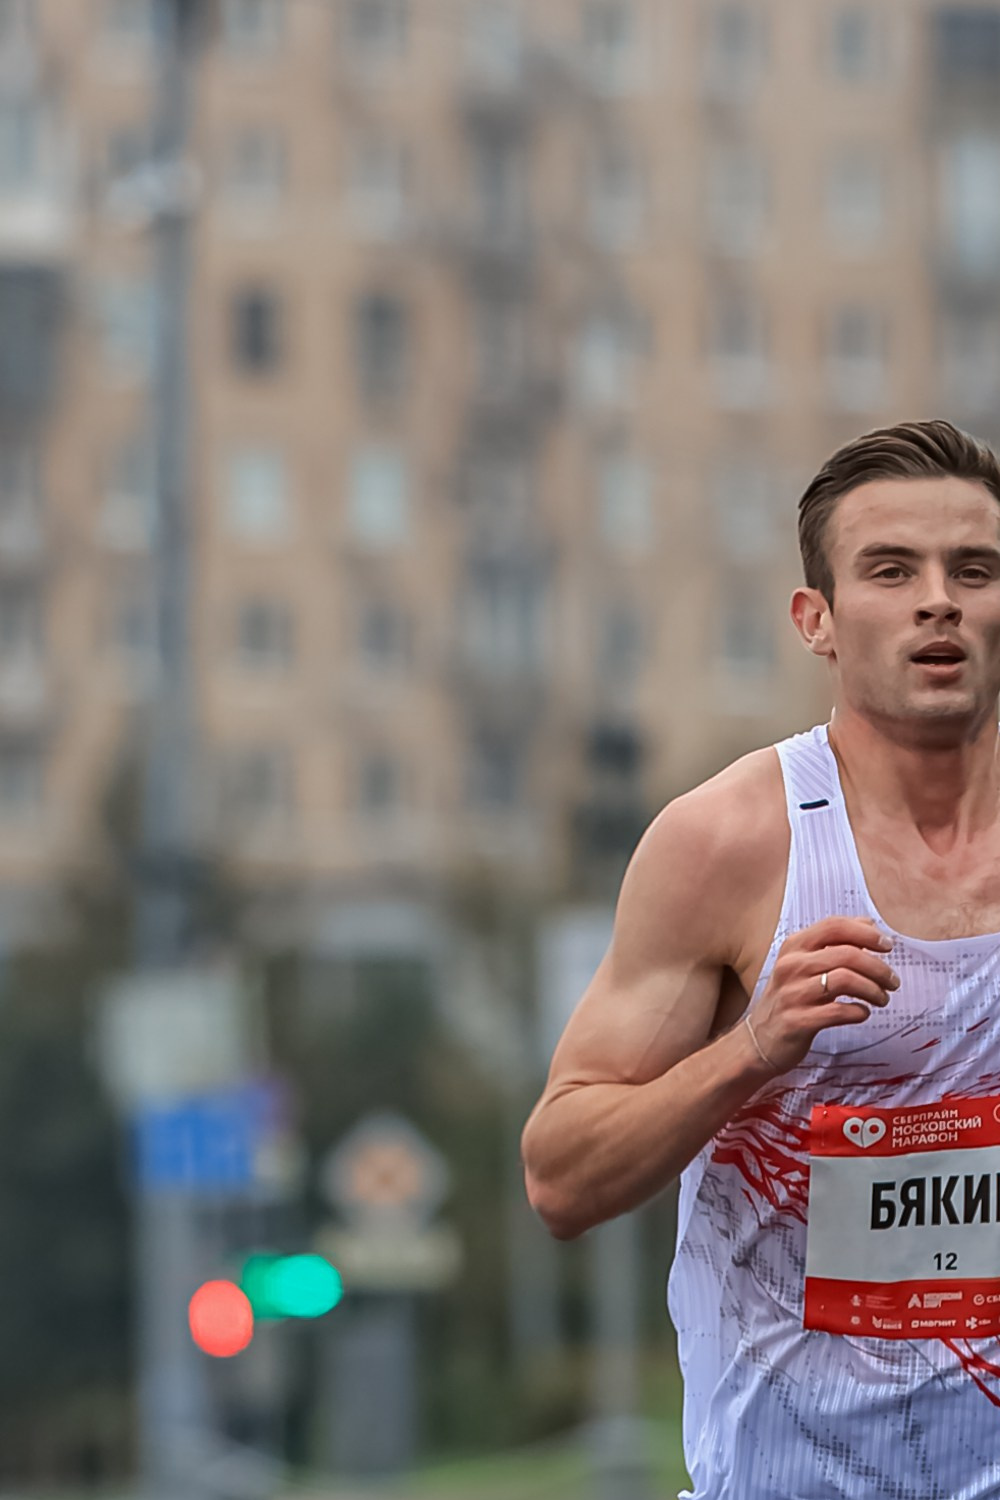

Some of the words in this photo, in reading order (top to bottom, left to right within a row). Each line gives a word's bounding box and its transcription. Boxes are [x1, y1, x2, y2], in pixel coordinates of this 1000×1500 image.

[892, 1109, 958, 1125] СБЕРПРАЙМ
[892, 1115, 982, 1137] МОСКОВСКИЙ
[892, 1131, 958, 1148] МАРАФОН
[933, 1252, 958, 1271] 12
